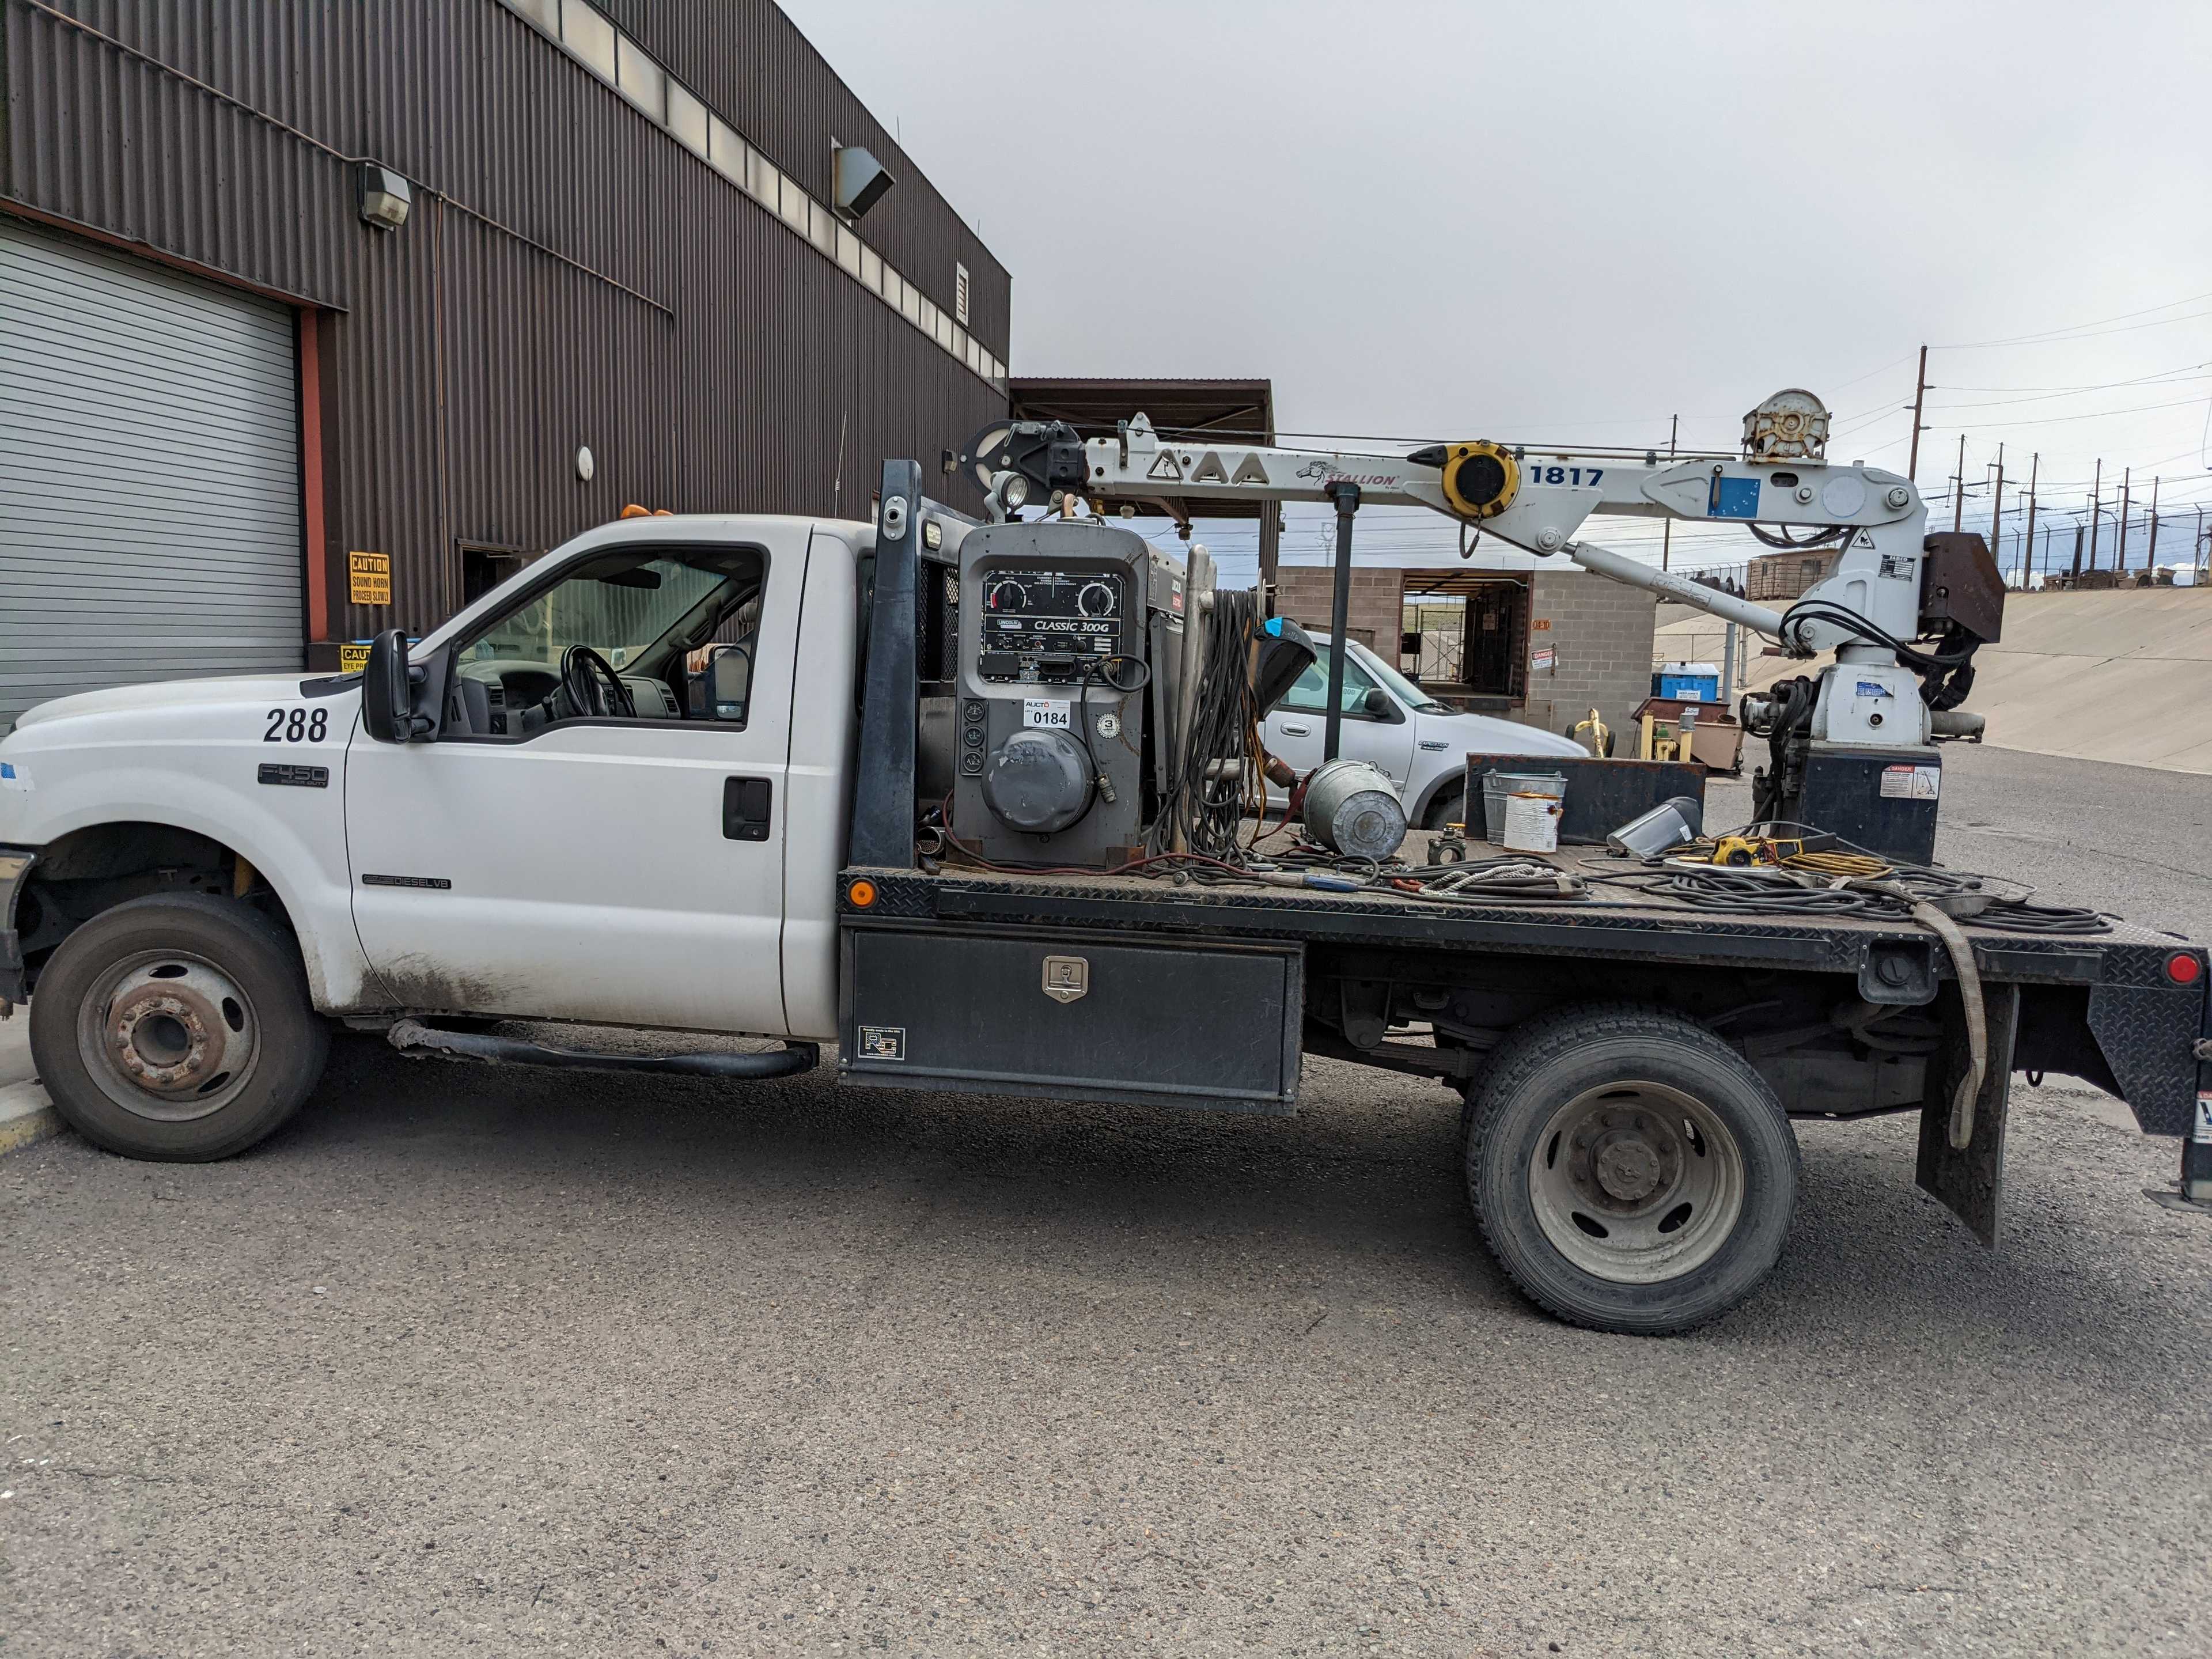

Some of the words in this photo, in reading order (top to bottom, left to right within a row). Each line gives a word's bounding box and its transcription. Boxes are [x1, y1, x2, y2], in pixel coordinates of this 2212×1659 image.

[1325, 474, 1396, 485] STALLION
[1530, 466, 1604, 486] 1817
[353, 557, 388, 572] CAUTION
[353, 576, 372, 588] SOUND
[373, 577, 388, 589] HORN
[353, 590, 372, 601] PROCEED
[373, 590, 388, 601] SLOWLY
[1035, 620, 1078, 631] CLASSIC
[1080, 622, 1109, 632] 300G
[344, 649, 371, 660] CAUT
[1033, 711, 1067, 725] 0184
[263, 708, 328, 743] 288
[395, 877, 433, 887] DIESEL
[433, 879, 449, 888] V8
[865, 1032, 897, 1054] RC
